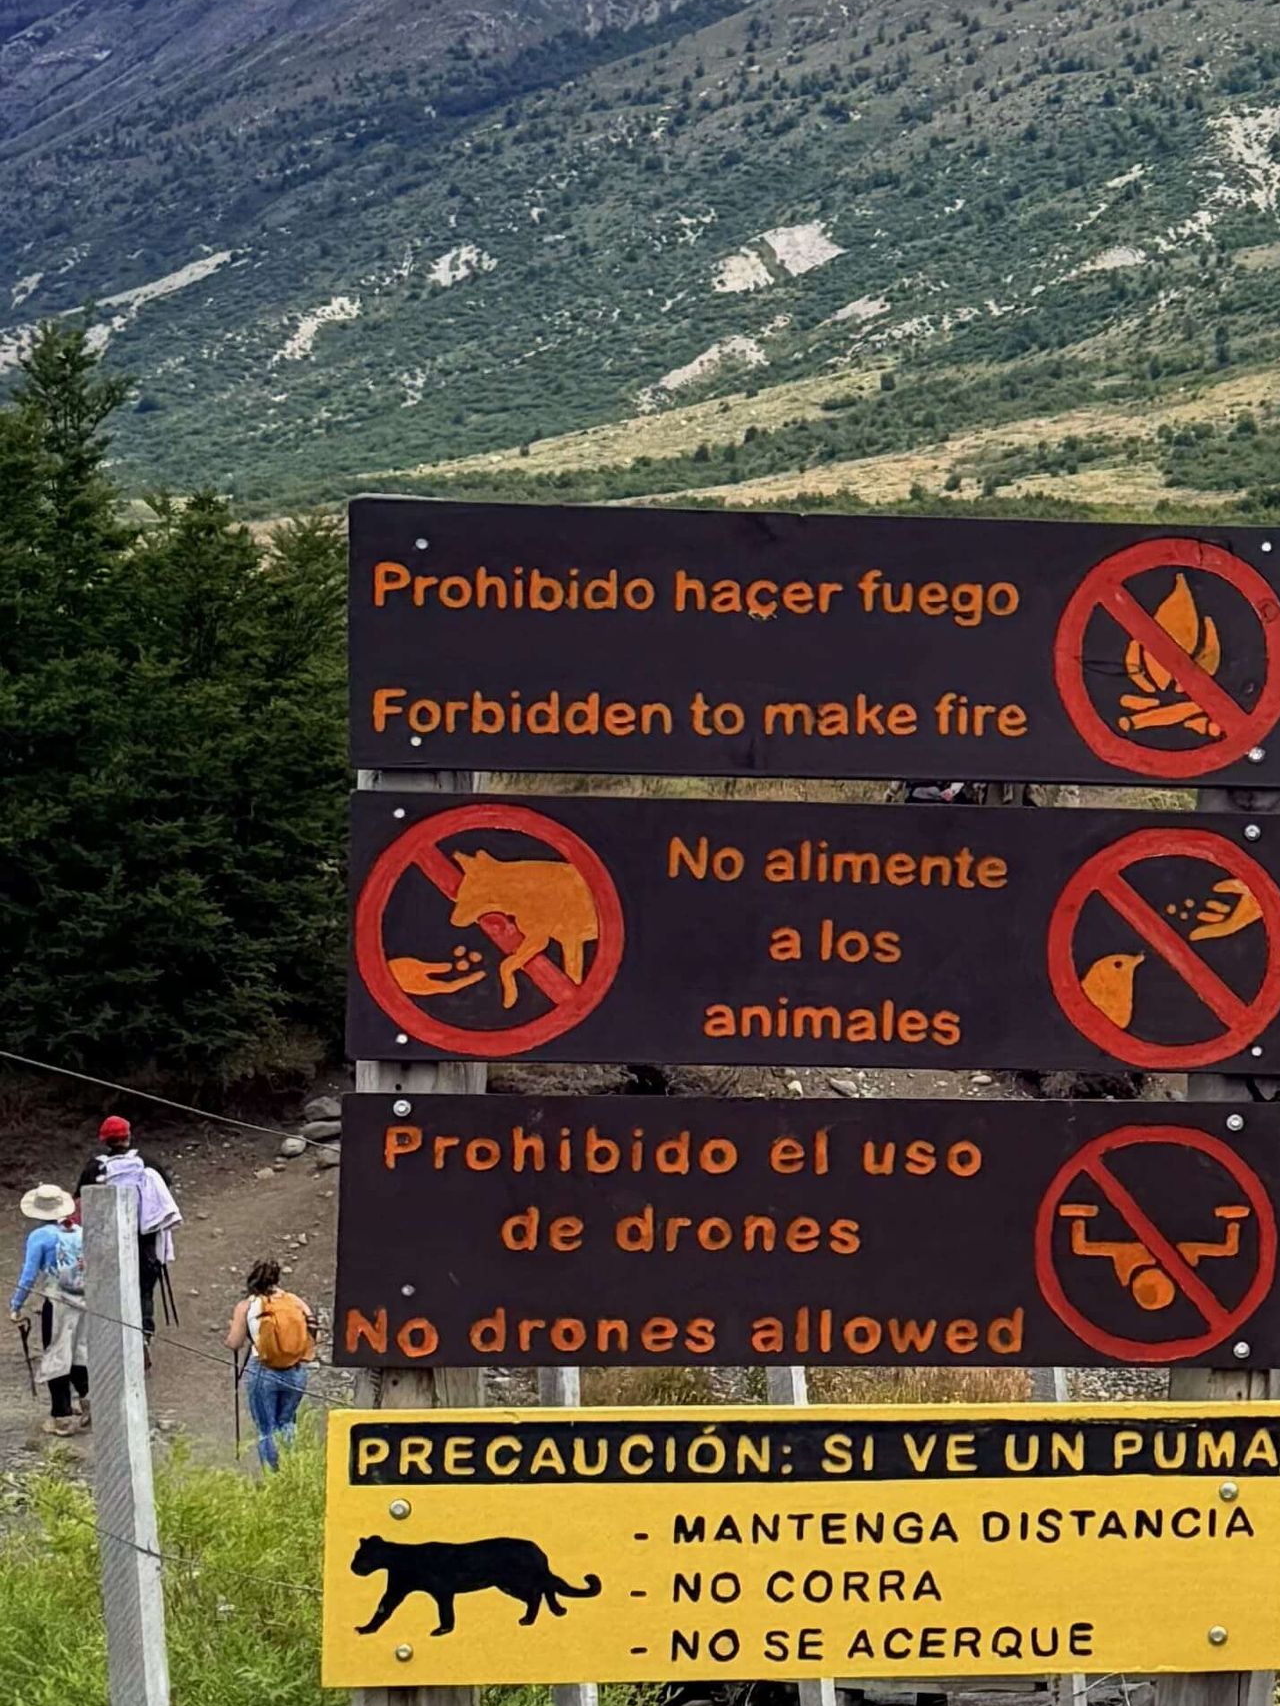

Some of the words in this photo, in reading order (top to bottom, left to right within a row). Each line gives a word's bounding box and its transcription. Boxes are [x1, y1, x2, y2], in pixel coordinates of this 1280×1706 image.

[374, 562, 654, 611] Prohibido
[858, 570, 1019, 626] fuego
[372, 688, 672, 736] Forbidden
[690, 693, 744, 736] to
[764, 695, 917, 736] make
[935, 693, 1026, 737] fire
[669, 837, 744, 881] No
[765, 841, 1006, 888] alimente
[769, 927, 801, 961] a
[821, 919, 901, 963] los
[704, 1000, 960, 1046] animales
[384, 1126, 737, 1175] Prohibido
[770, 1132, 828, 1175] el
[863, 1141, 982, 1177] uso
[501, 1206, 583, 1251] de
[616, 1207, 860, 1254] drones
[346, 1309, 439, 1358] No
[470, 1308, 715, 1353] drones
[751, 1307, 1023, 1354] allowed
[358, 1425, 793, 1476] PRECAUCIÓN:
[822, 1434, 874, 1473] SI
[903, 1433, 977, 1472] VE
[1004, 1432, 1084, 1472] UN
[1114, 1428, 1279, 1469] PUMA
[673, 1511, 958, 1545] MANTENGA
[982, 1506, 1254, 1544] DISTANCIA
[673, 1572, 741, 1604] NO
[766, 1569, 942, 1603] CORRA
[671, 1628, 740, 1662] NO
[764, 1628, 823, 1662] SE
[847, 1622, 1094, 1660] ACERQUE
